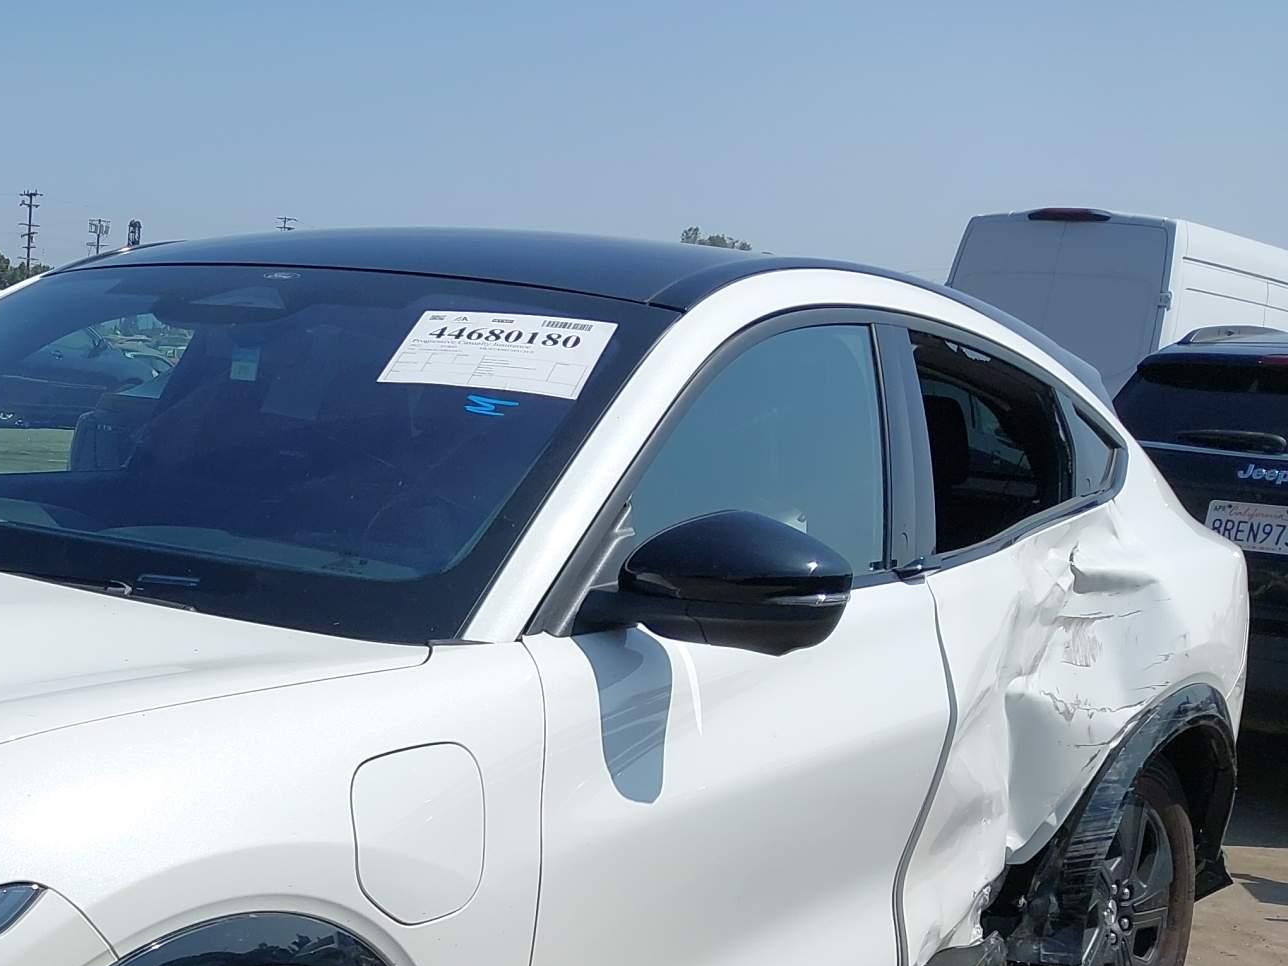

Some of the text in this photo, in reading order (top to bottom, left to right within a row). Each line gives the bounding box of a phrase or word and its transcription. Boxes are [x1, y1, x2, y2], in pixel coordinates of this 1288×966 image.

[428, 326, 581, 349] 44680180
[1237, 463, 1288, 485] Jeep
[1212, 518, 1288, 546] 8REN97
